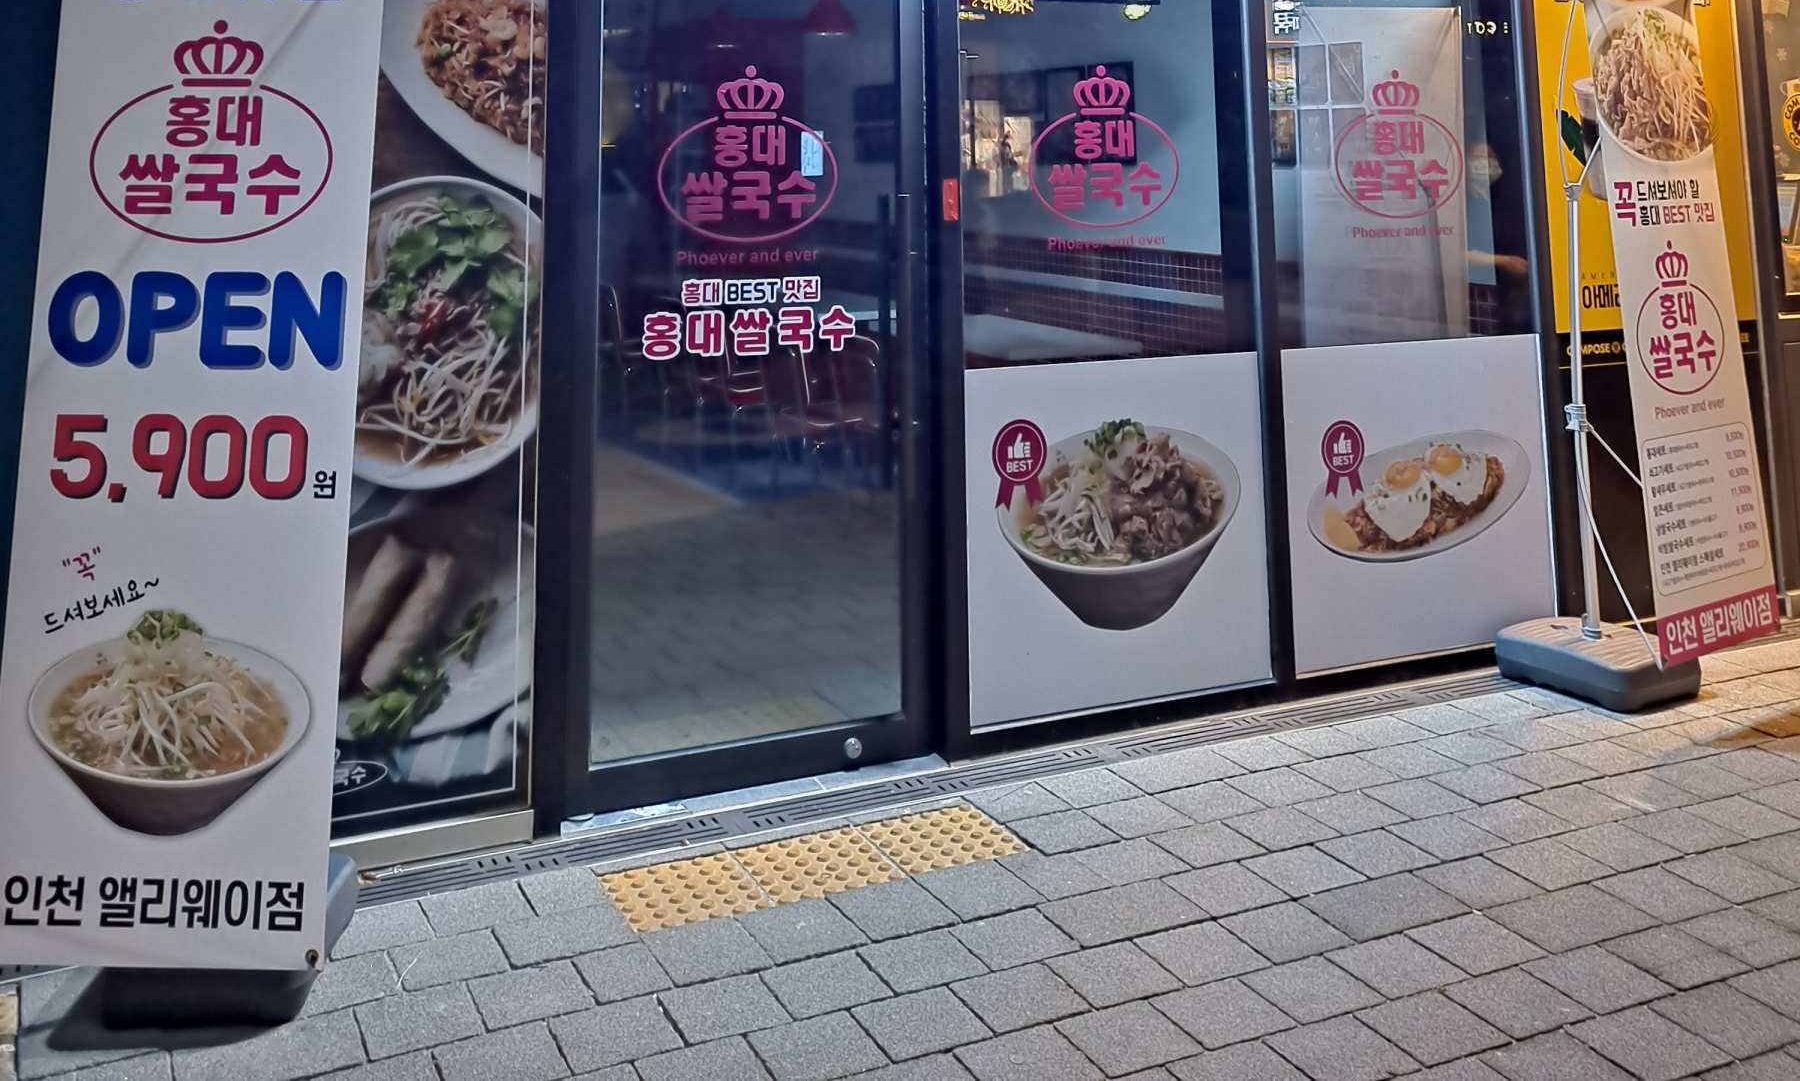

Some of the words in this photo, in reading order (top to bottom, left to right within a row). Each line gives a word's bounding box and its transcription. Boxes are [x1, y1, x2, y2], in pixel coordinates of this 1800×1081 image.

[165, 95, 263, 148] 홍대
[1074, 120, 1135, 160] 홍대
[1375, 120, 1425, 155] 홍대
[714, 125, 786, 168] 홍대
[119, 154, 301, 215] 쌀국수
[682, 170, 816, 221] 쌀국수
[1049, 162, 1162, 210] 쌀국수
[1353, 159, 1449, 201] 쌀국수
[1614, 182, 1636, 227] 꼭
[1663, 205, 1692, 224] BEST
[1694, 203, 1715, 223] 맛집
[1048, 236, 1104, 252] Phoever
[1108, 235, 1134, 249] and
[1136, 235, 1167, 247] ever
[1404, 224, 1426, 237] and
[676, 250, 745, 266] Phoever
[749, 247, 780, 263] and
[785, 249, 820, 262] ever
[682, 279, 722, 305] 홍대
[726, 280, 779, 303] BEST
[783, 277, 819, 302] 맛집
[1659, 291, 1697, 330] 홍대
[48, 270, 348, 371] OPEN
[643, 306, 856, 359] 홍대쌀국수
[1567, 342, 1611, 357] CMPOSE
[1649, 330, 1717, 379] 쌀국수
[1655, 404, 1689, 420] Phoever
[1691, 400, 1706, 414] and
[1708, 399, 1725, 411] ever
[1006, 459, 1033, 473] BEST
[1333, 454, 1355, 467] BEST
[1666, 615, 1699, 656] 인천
[1699, 592, 1773, 645] 앨리웨이점
[4, 874, 86, 926] 인천
[99, 877, 305, 932] 앨리웨이점
